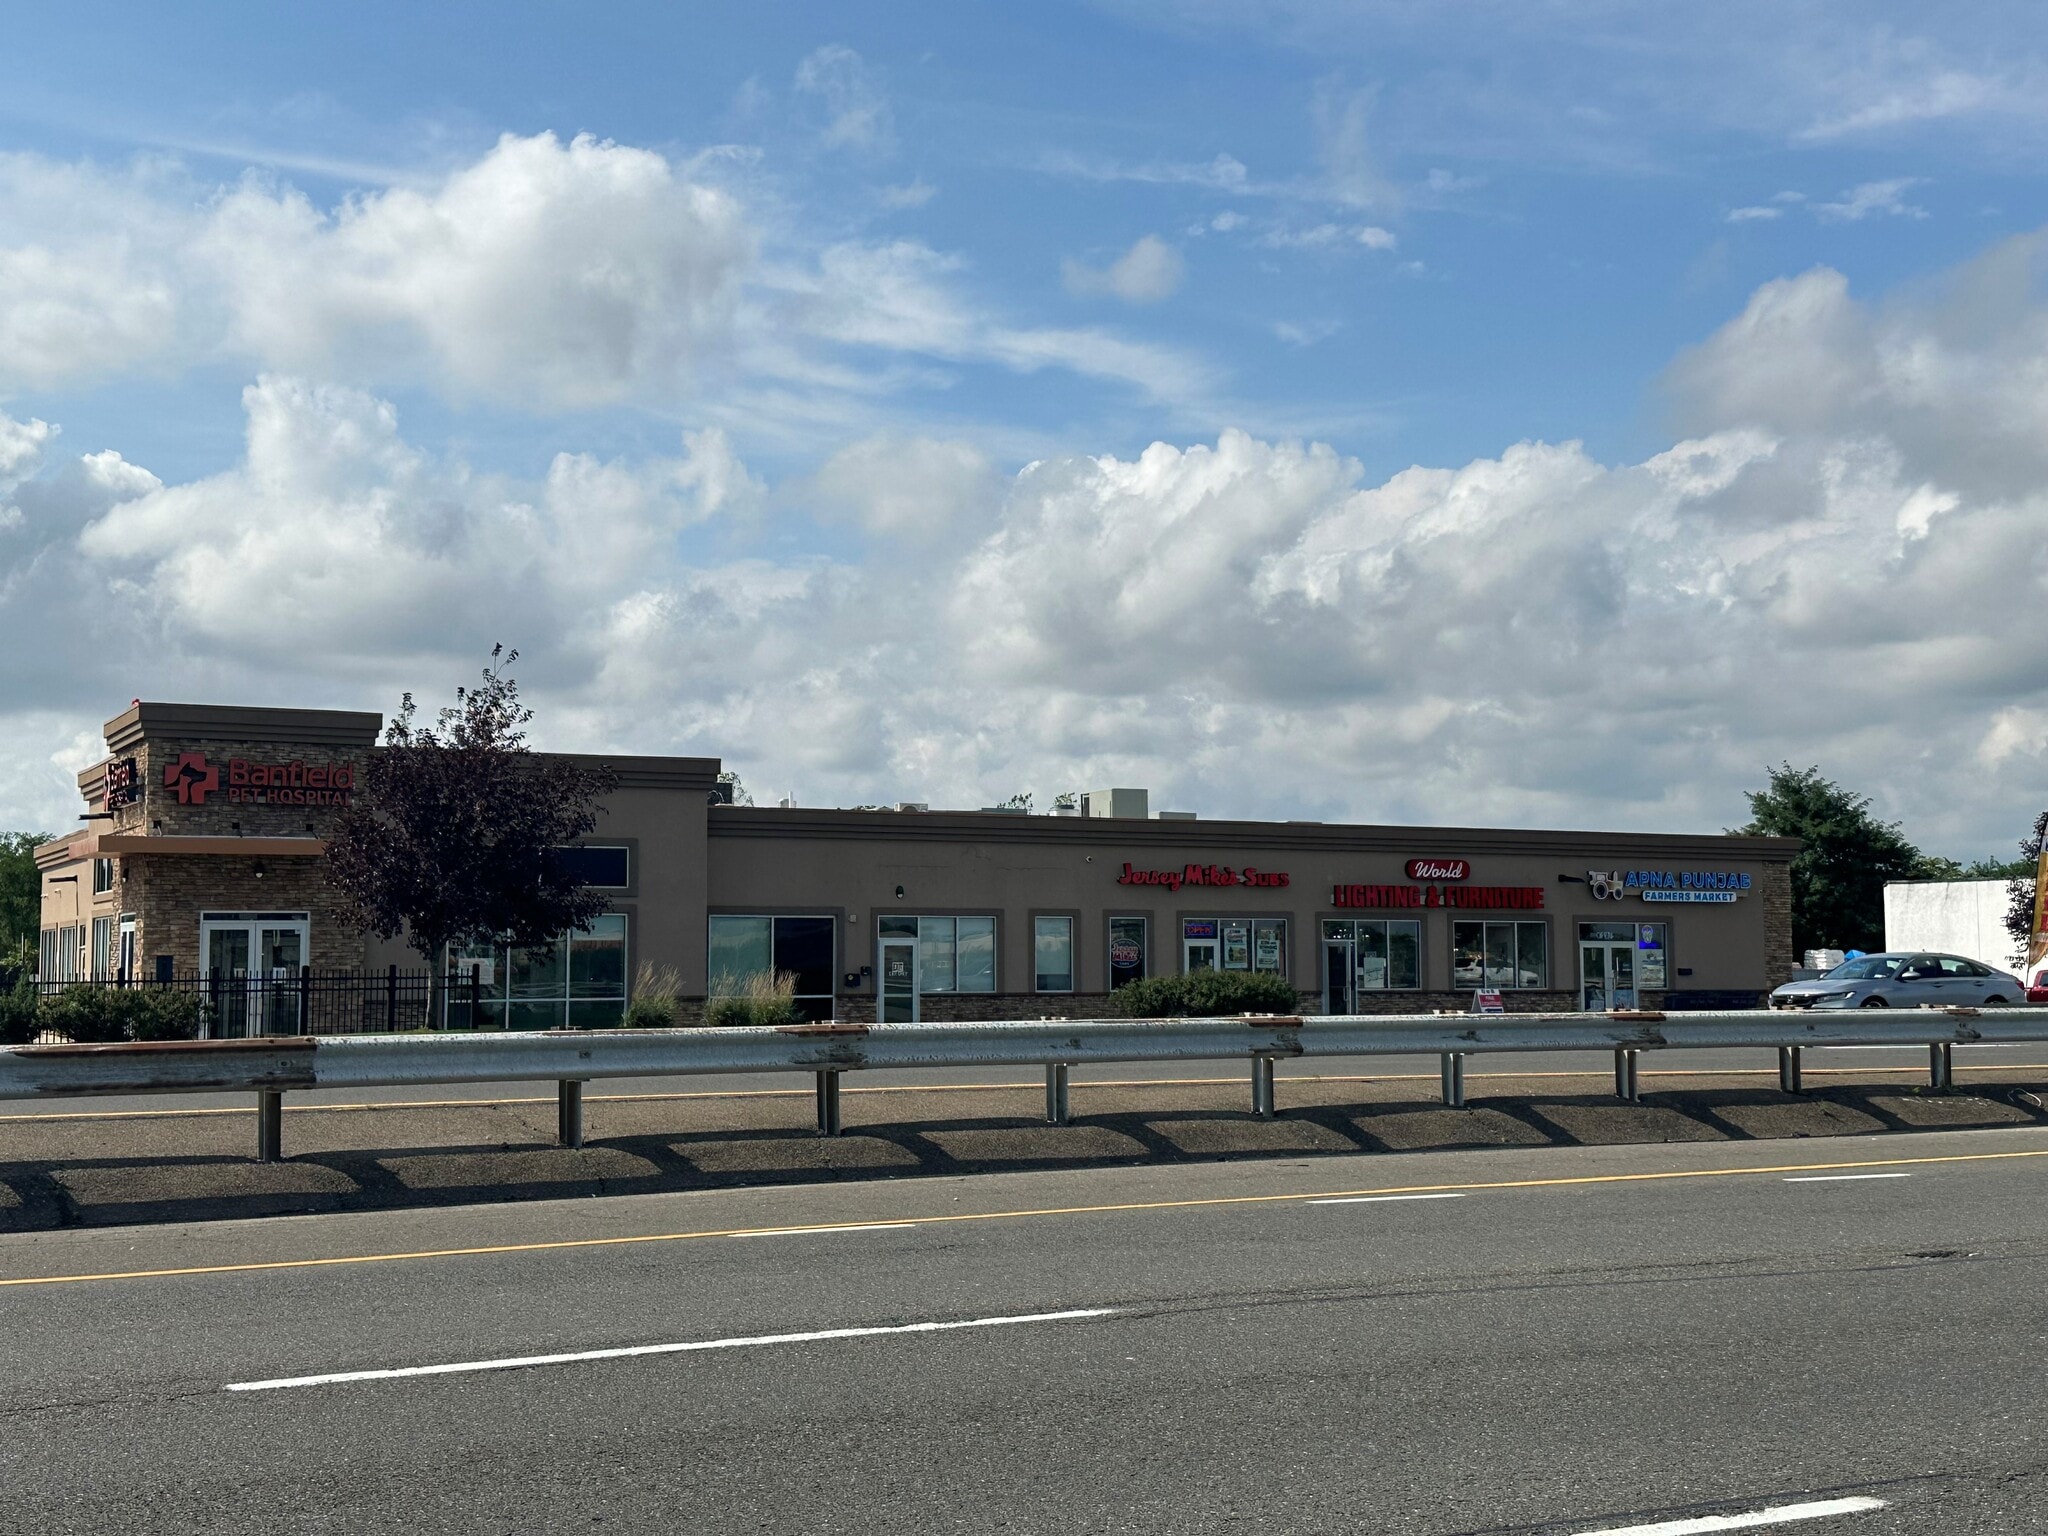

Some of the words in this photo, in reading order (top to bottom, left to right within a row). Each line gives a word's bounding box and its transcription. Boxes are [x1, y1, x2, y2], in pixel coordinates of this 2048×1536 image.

[229, 759, 354, 789] Banfield
[228, 788, 261, 803] PET
[266, 789, 352, 807] HOSPITAL
[1118, 863, 1182, 891] Jersey
[1183, 864, 1239, 887] Mike's
[1414, 861, 1463, 878] World
[1624, 871, 1675, 888] APNA
[1680, 872, 1752, 890] PUNJAB
[1333, 885, 1421, 908] LIGHTING
[1425, 885, 1440, 908] &
[1443, 886, 1545, 909] FURNITURE
[1645, 891, 1691, 901] FARMERS
[1694, 892, 1735, 902] MARKET
